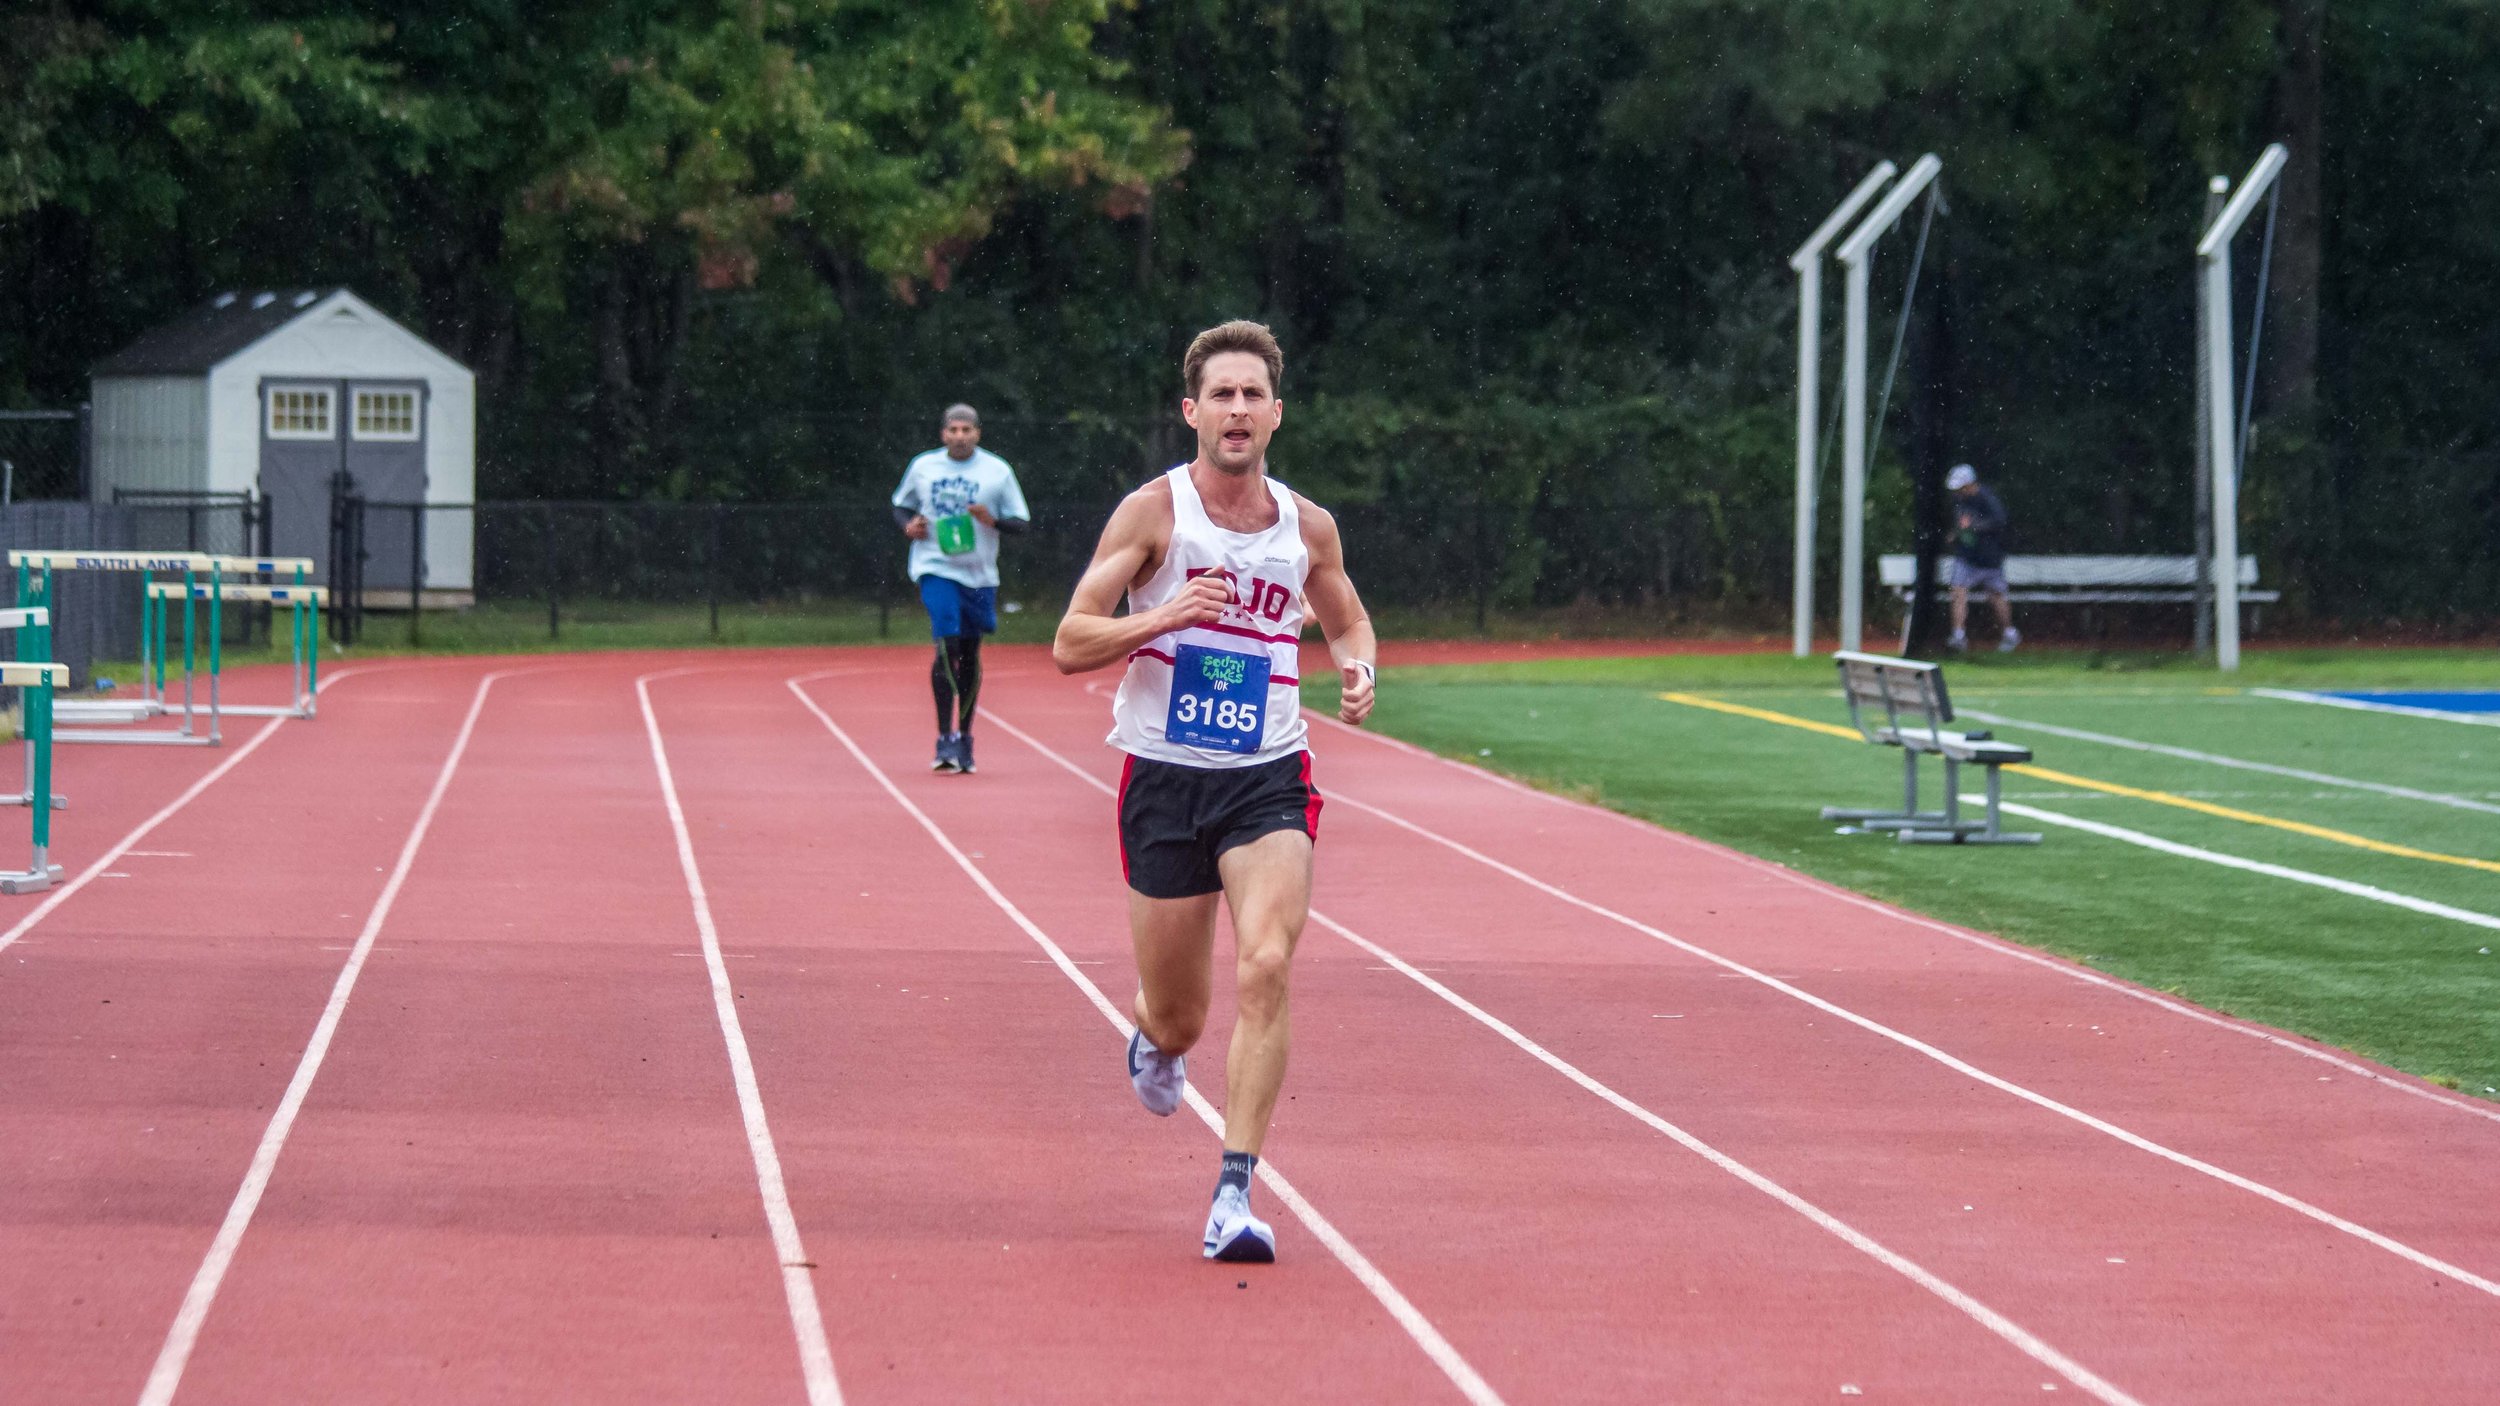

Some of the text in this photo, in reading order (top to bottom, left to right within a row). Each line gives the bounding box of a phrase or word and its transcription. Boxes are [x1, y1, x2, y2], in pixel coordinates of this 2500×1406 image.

[76, 558, 190, 571] SOUTH LAKES
[1203, 655, 1246, 673] SOUTH
[1202, 666, 1244, 684] LAKES
[1213, 679, 1230, 692] 10K
[1177, 693, 1258, 733] 3185
